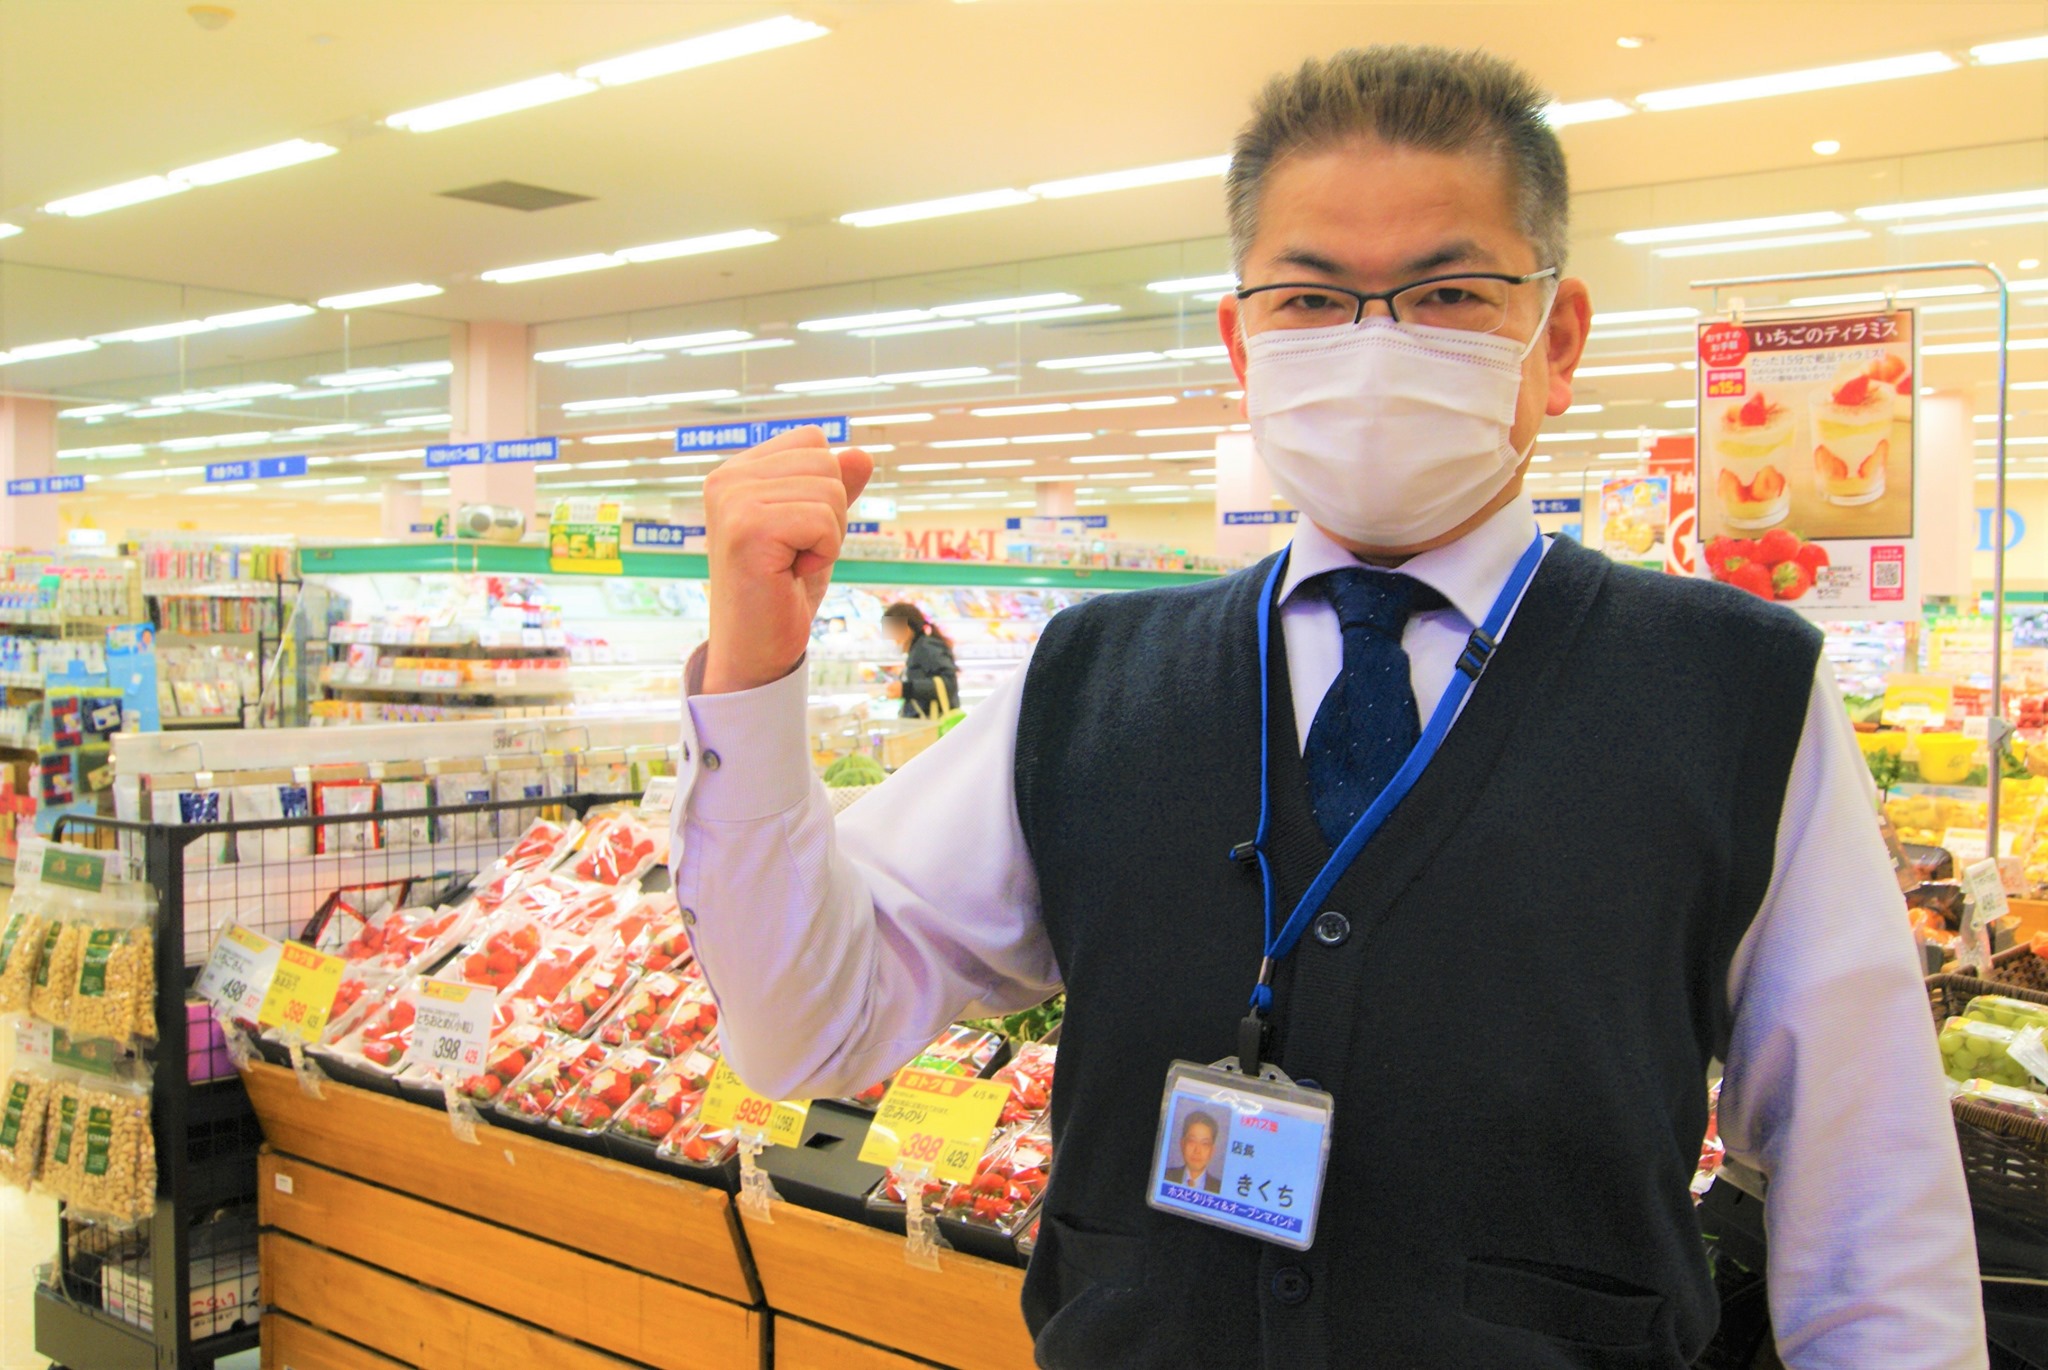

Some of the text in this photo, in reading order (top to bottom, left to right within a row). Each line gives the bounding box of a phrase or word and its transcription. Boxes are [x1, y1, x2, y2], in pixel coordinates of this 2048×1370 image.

[1755, 320, 1898, 346] いちごのティラミス
[904, 528, 1003, 561] MEAT
[222, 978, 247, 1002] 498
[434, 1035, 462, 1060] 398
[735, 1097, 772, 1127] 980
[882, 1105, 928, 1125] 恋みのり
[901, 1132, 969, 1169] 398 429
[1231, 1140, 1255, 1158] 店長
[1236, 1173, 1294, 1208] きくち
